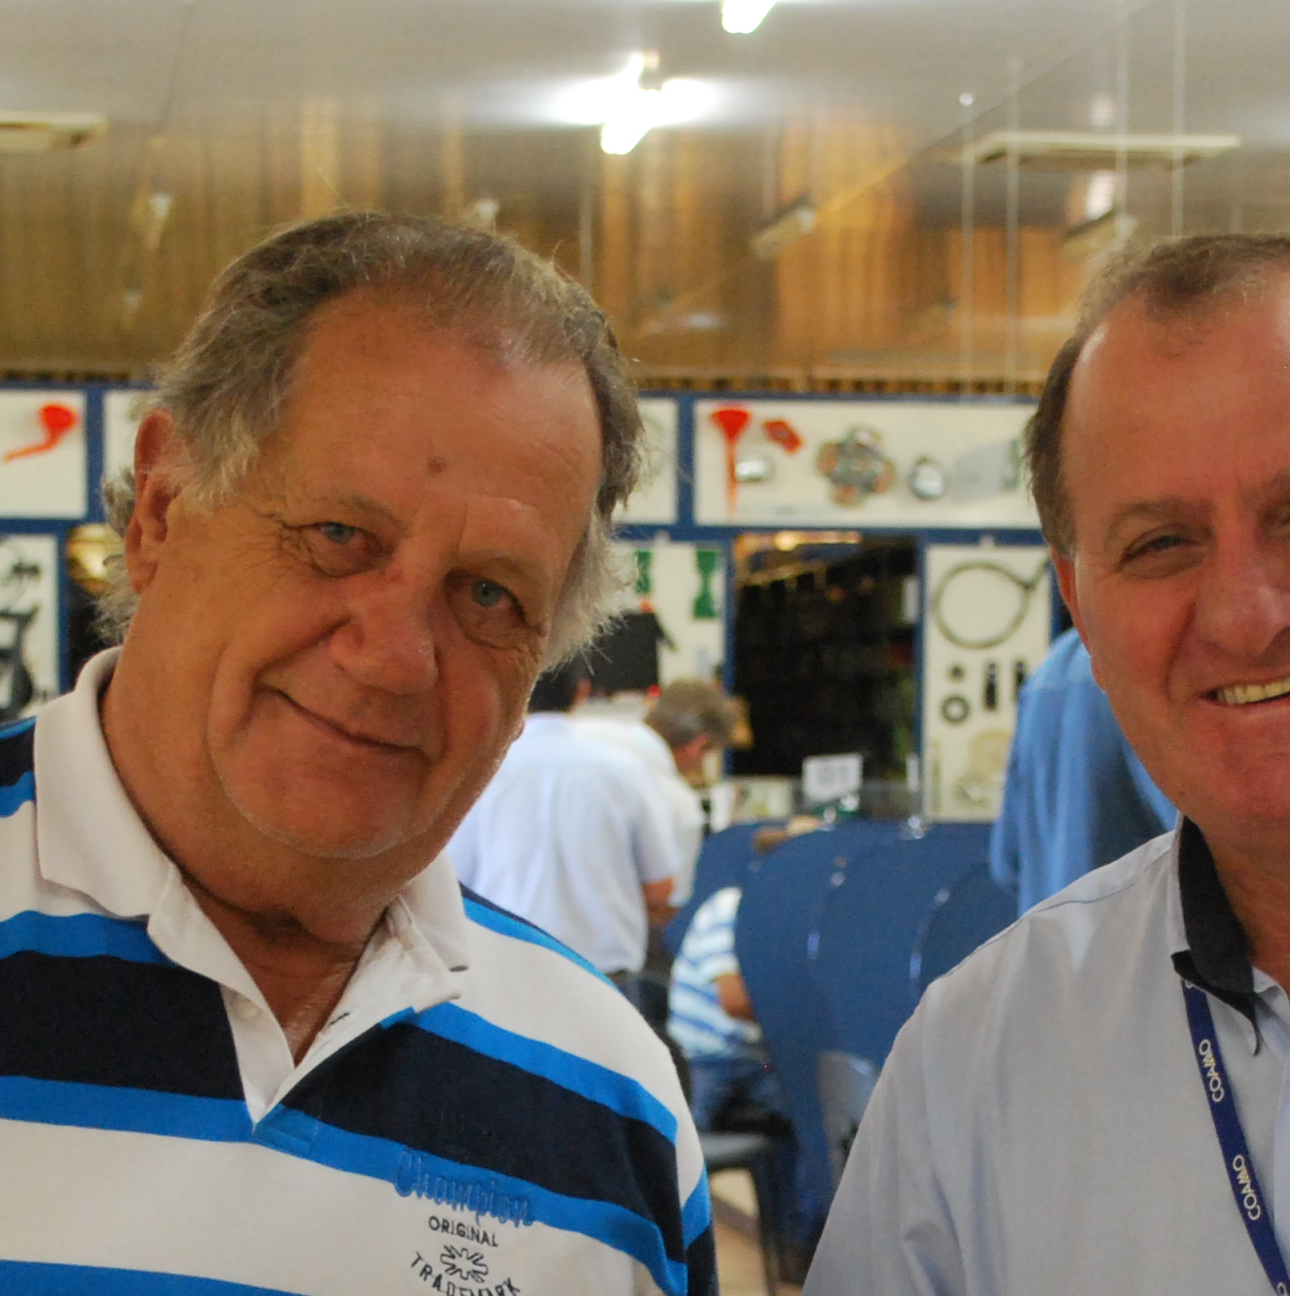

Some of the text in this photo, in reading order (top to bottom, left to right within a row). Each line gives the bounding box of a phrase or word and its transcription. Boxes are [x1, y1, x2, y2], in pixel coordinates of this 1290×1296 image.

[1198, 1038, 1225, 1103] COAMO
[1232, 1154, 1262, 1221] COAMO
[428, 1214, 499, 1248] ORIGINAL
